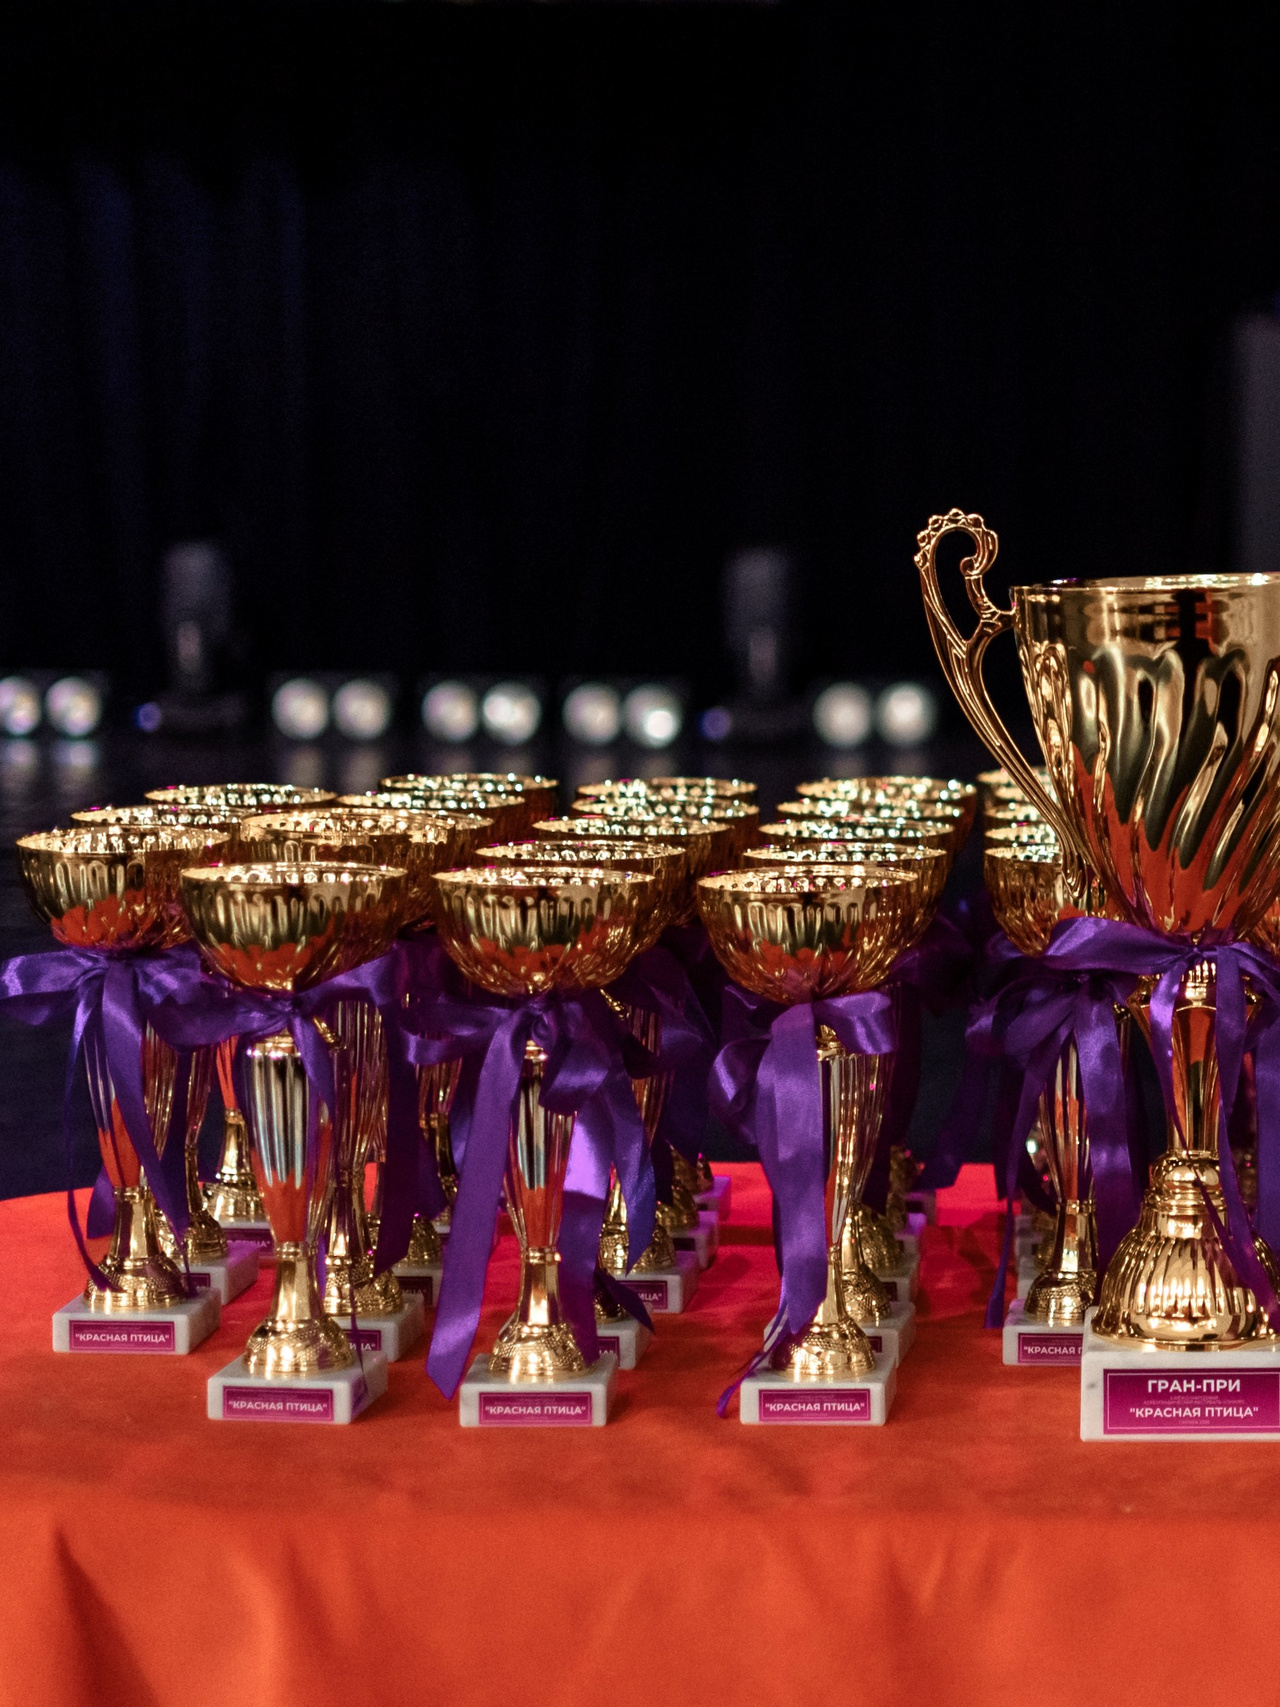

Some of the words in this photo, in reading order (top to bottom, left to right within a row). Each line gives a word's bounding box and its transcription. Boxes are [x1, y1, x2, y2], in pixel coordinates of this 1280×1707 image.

[75, 1333, 128, 1342] "КРАСНАЯ
[130, 1333, 170, 1343] ПТИЦА"
[1023, 1346, 1076, 1355] "КРАСНАЯ
[1147, 1379, 1241, 1393] ГРАН-ПРИ
[228, 1400, 283, 1411] "КРАСНАЯ
[286, 1402, 328, 1412] ПТИЦА"
[485, 1405, 541, 1415] "КРАСНАЯ
[544, 1405, 586, 1416] ПТИЦА"
[765, 1402, 821, 1412] "КРАСНАЯ
[823, 1402, 865, 1412] ПТИЦА"
[1130, 1406, 1201, 1418] "КРАСНАЯ
[1205, 1406, 1259, 1419] ПТИЦА"
